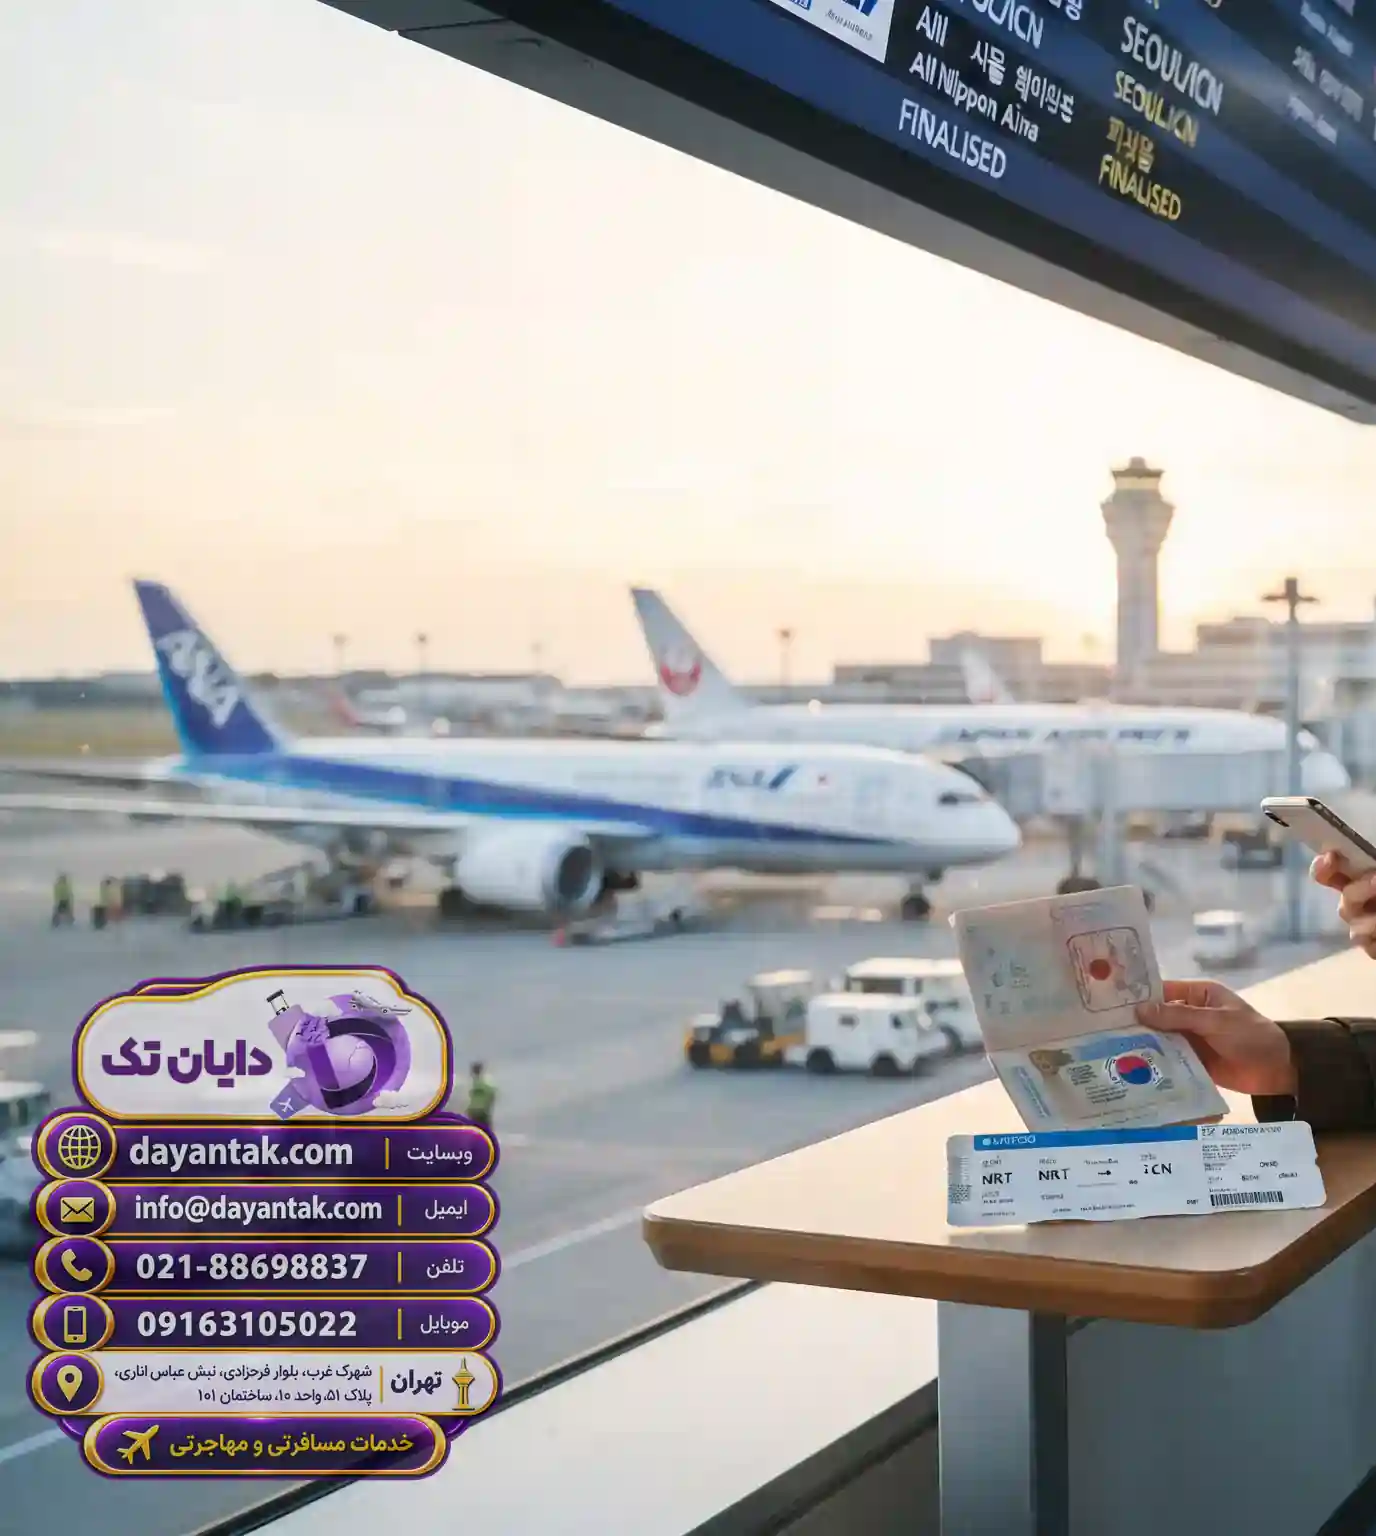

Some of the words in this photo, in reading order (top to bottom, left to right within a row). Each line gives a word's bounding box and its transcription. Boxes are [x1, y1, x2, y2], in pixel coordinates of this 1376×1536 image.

[899, 98, 1007, 179] FINALISED
[1098, 153, 1182, 221] FINALISED
[982, 1172, 1013, 1185] NRT
[1038, 1168, 1071, 1181] NRT
